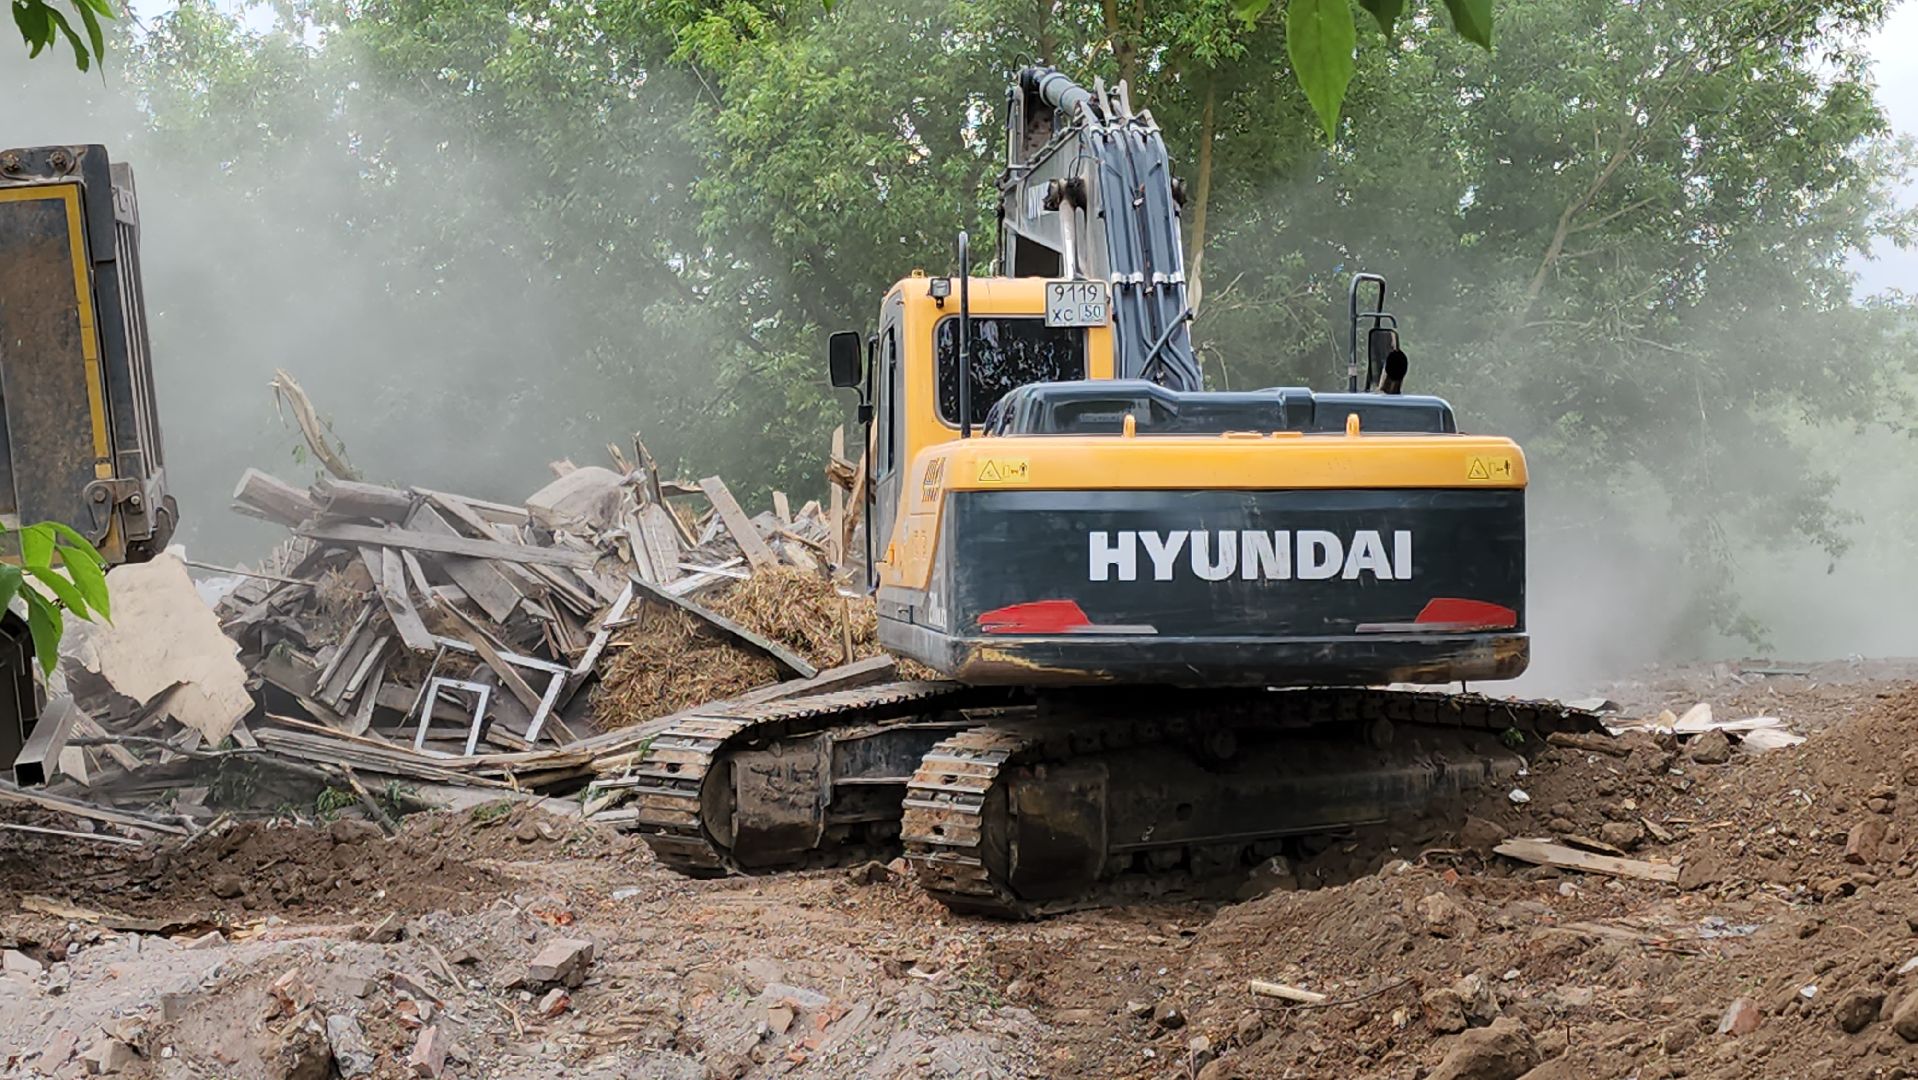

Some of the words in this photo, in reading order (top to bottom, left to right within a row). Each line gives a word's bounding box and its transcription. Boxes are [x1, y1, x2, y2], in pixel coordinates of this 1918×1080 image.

[1055, 285, 1098, 302] 9119
[1053, 309, 1073, 321] XC
[1085, 305, 1101, 318] 50
[1089, 530, 1412, 581] HYUNDAI
